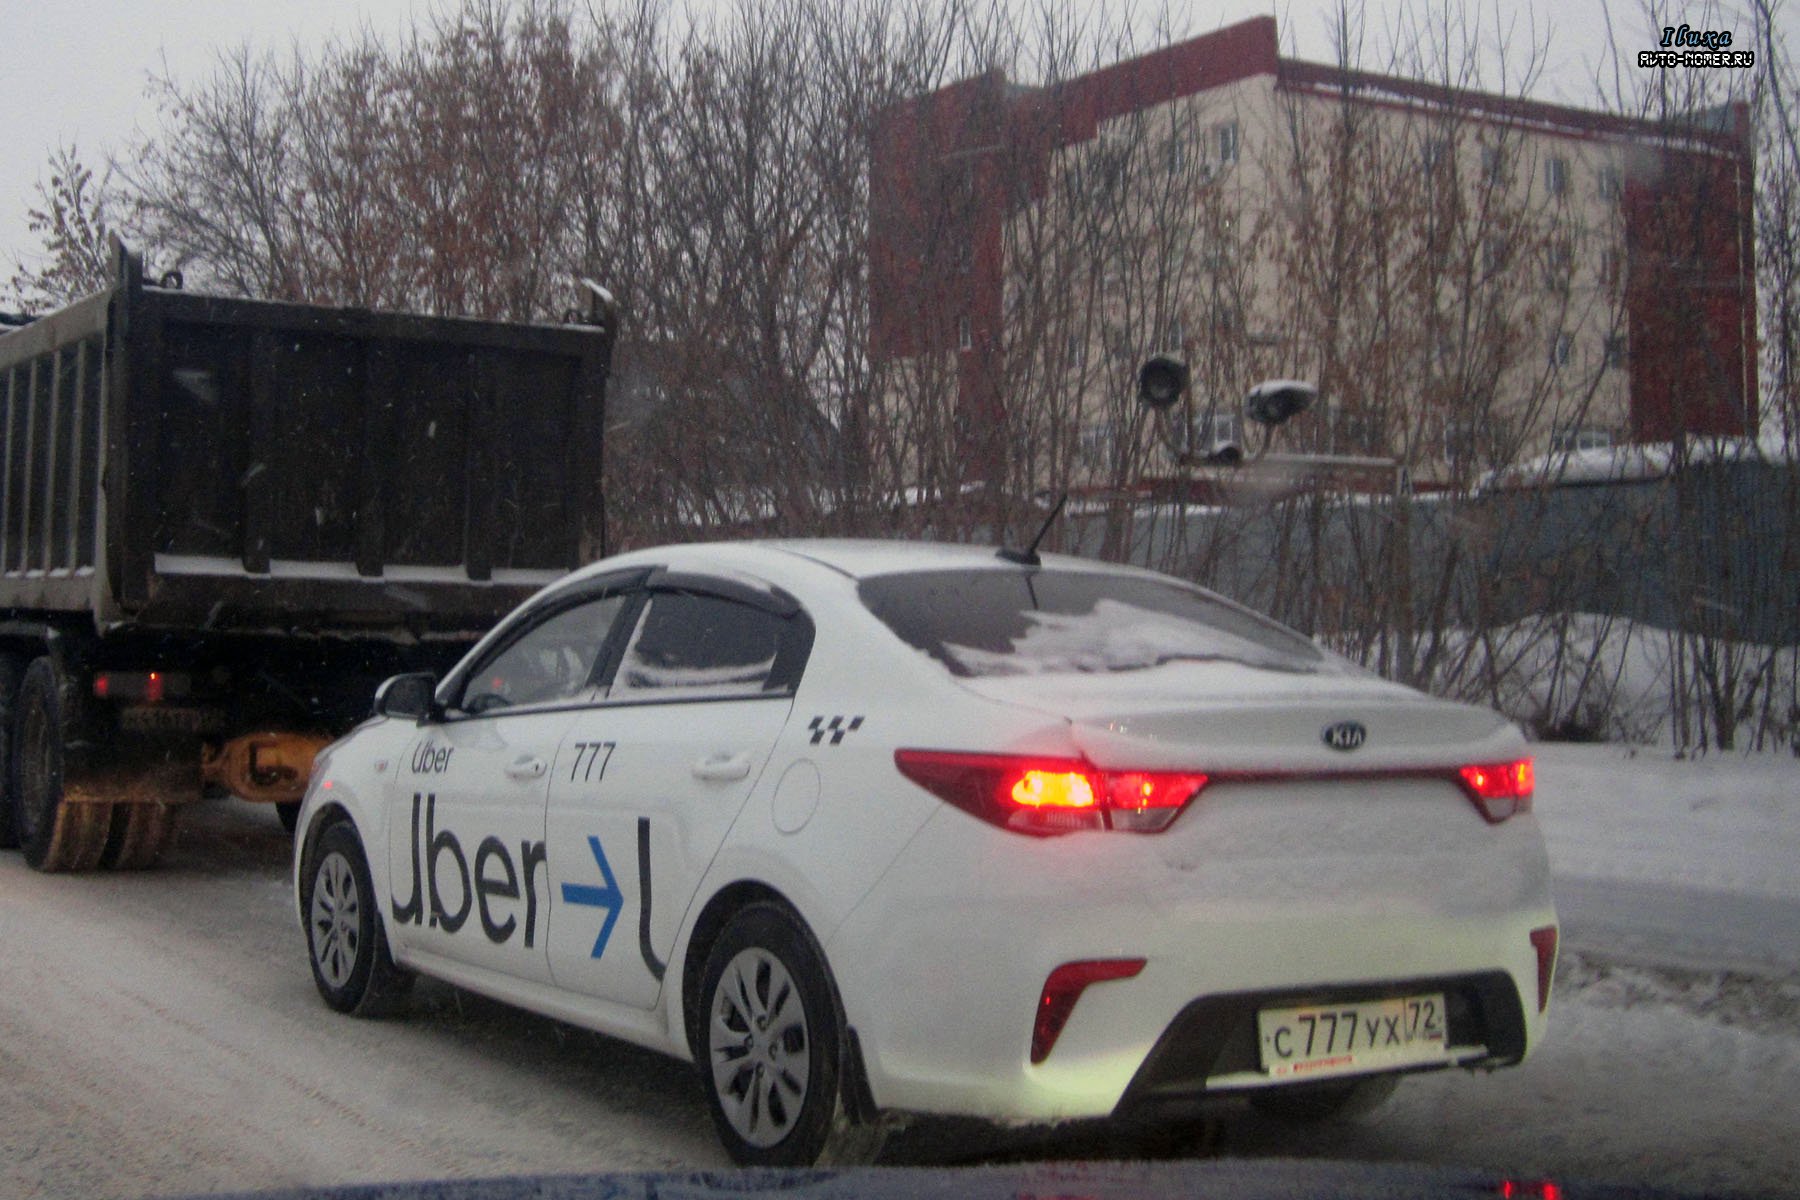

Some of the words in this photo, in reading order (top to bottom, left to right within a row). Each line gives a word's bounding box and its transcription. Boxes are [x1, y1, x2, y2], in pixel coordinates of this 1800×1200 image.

[1332, 728, 1363, 746] KIA
[411, 741, 454, 773] Uber
[570, 741, 616, 782] 777
